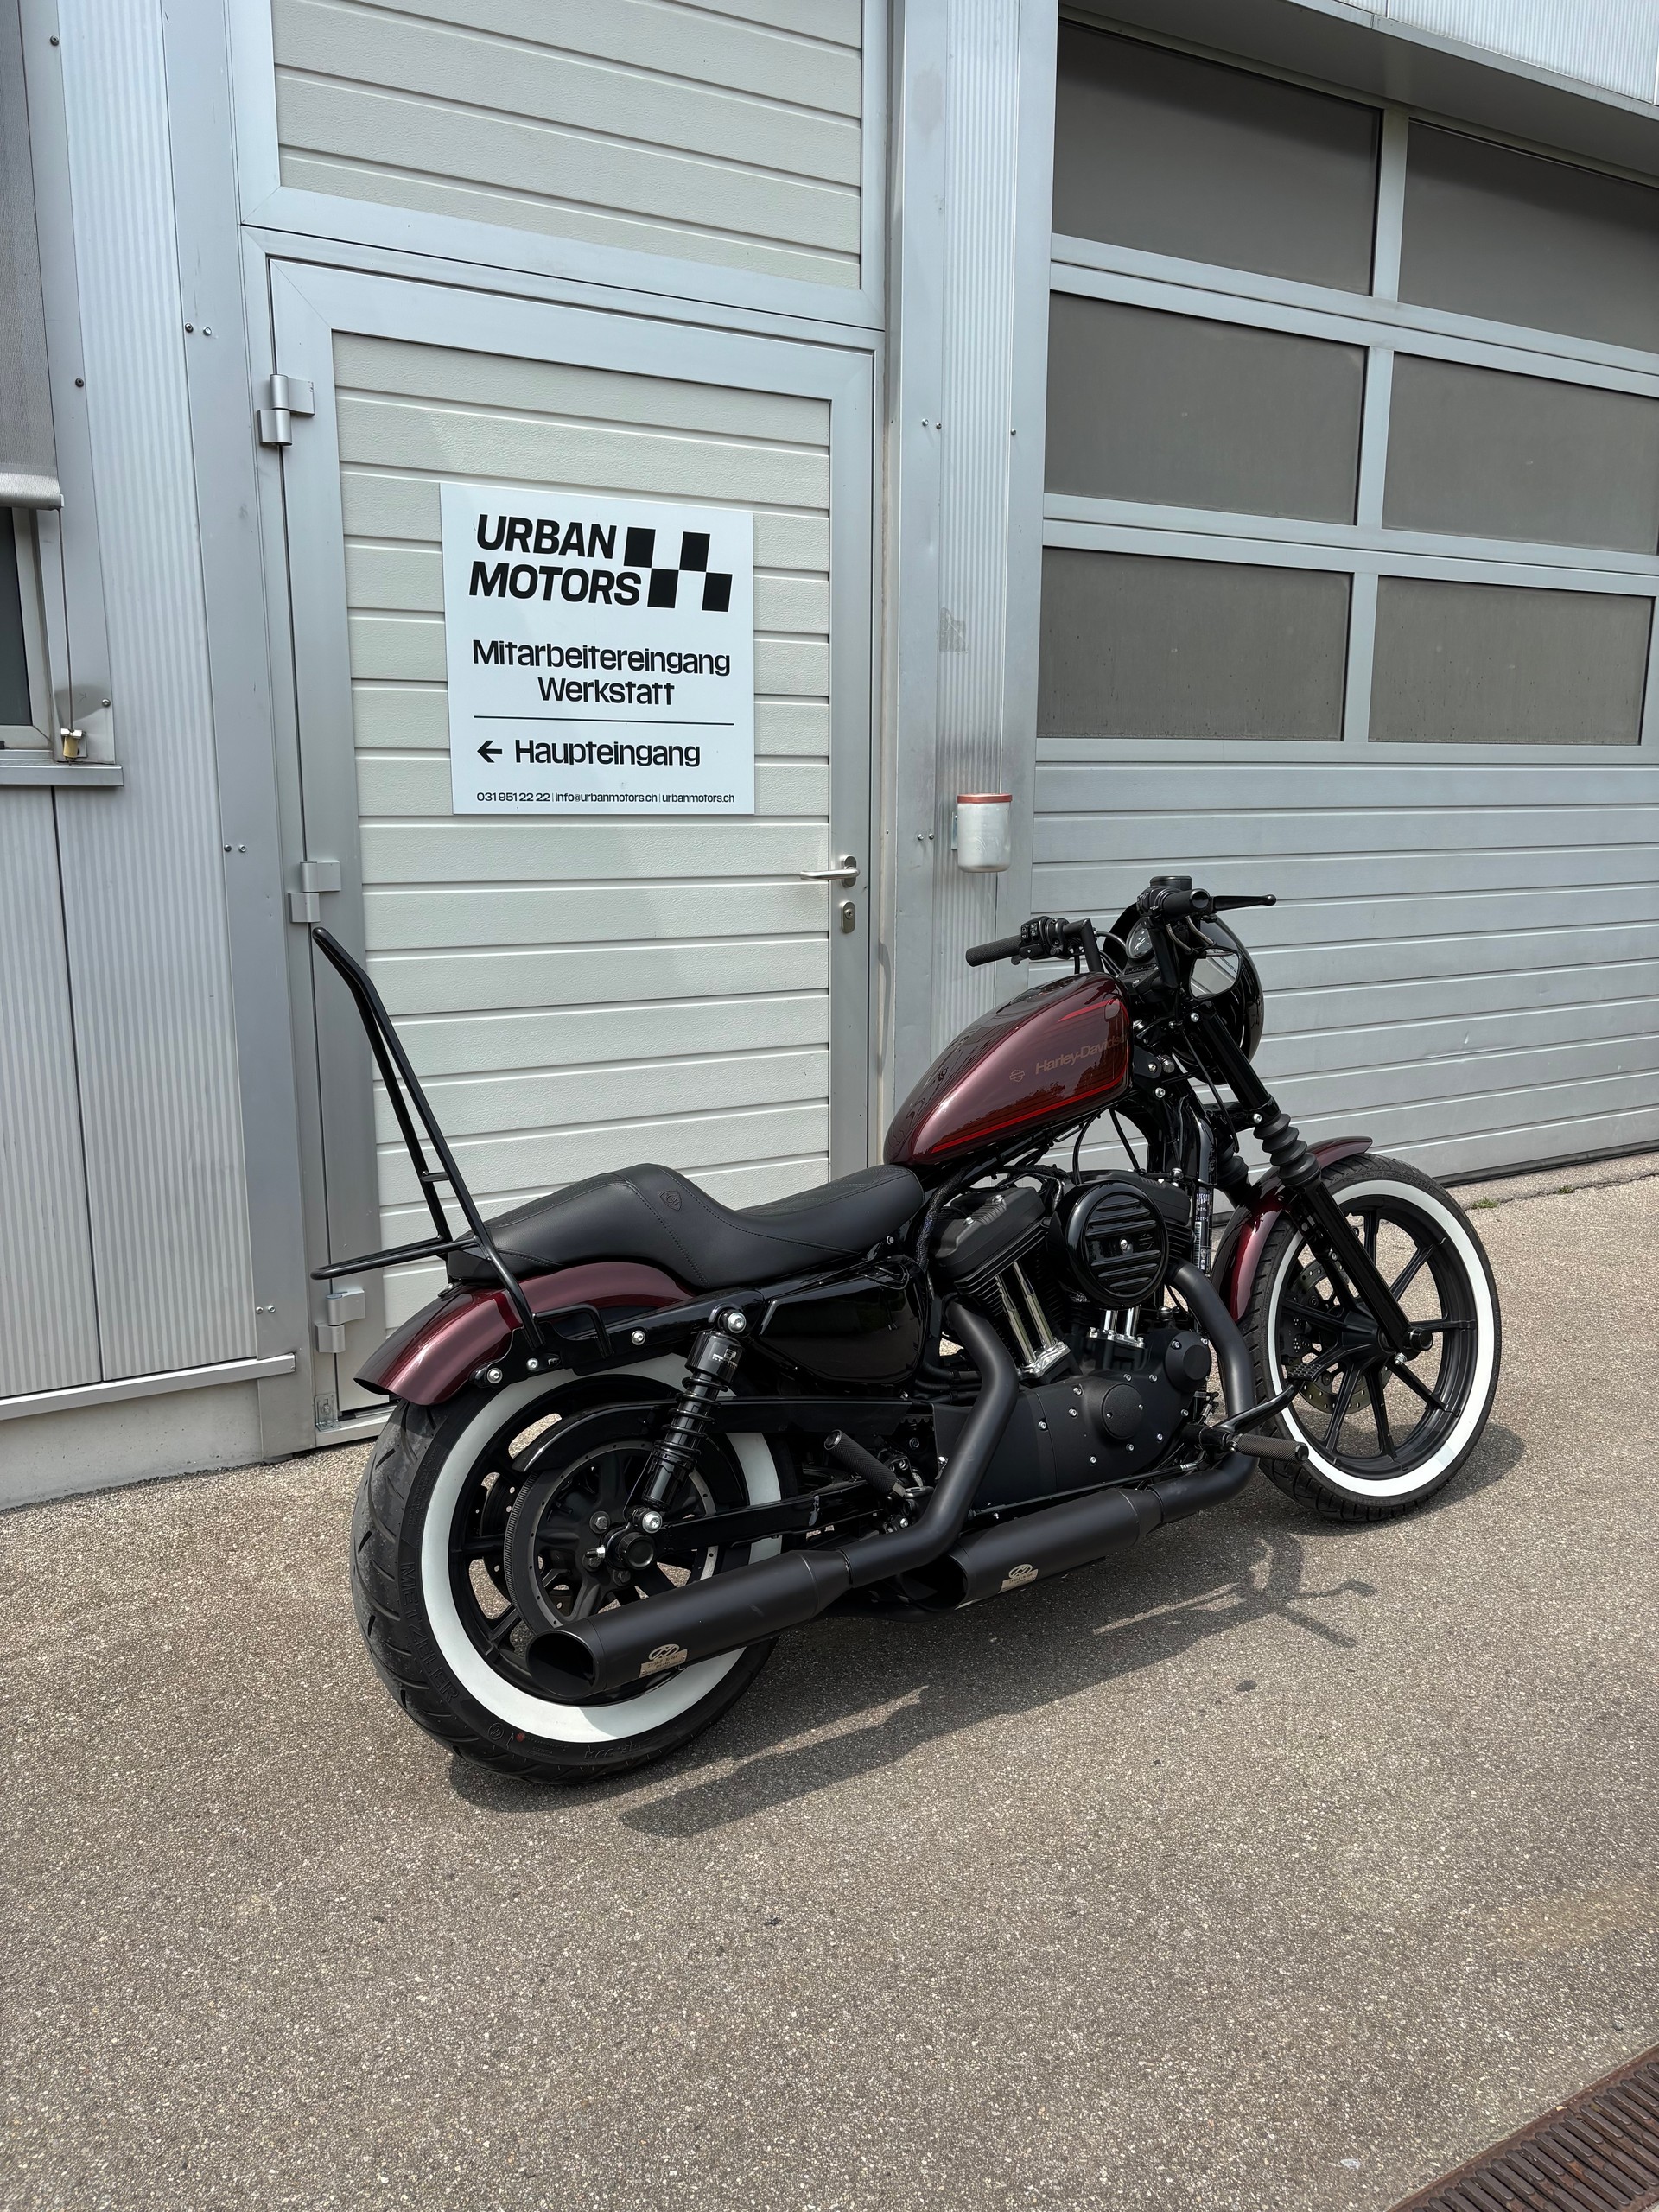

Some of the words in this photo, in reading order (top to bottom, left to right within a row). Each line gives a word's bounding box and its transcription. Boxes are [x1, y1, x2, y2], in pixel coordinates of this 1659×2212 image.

[476, 513, 618, 560] URBAN
[468, 560, 642, 607] MOTORS
[473, 639, 731, 677] Mitarbeitereingang
[537, 677, 676, 706] Werkstatt
[515, 739, 701, 768] Haupteingang
[476, 791, 497, 802] 031
[498, 791, 518, 802] 951
[518, 792, 534, 802] 22
[535, 792, 551, 802] 22
[555, 792, 658, 803] info@urbanmotors.ch
[662, 793, 735, 803] urbanmotors.ch
